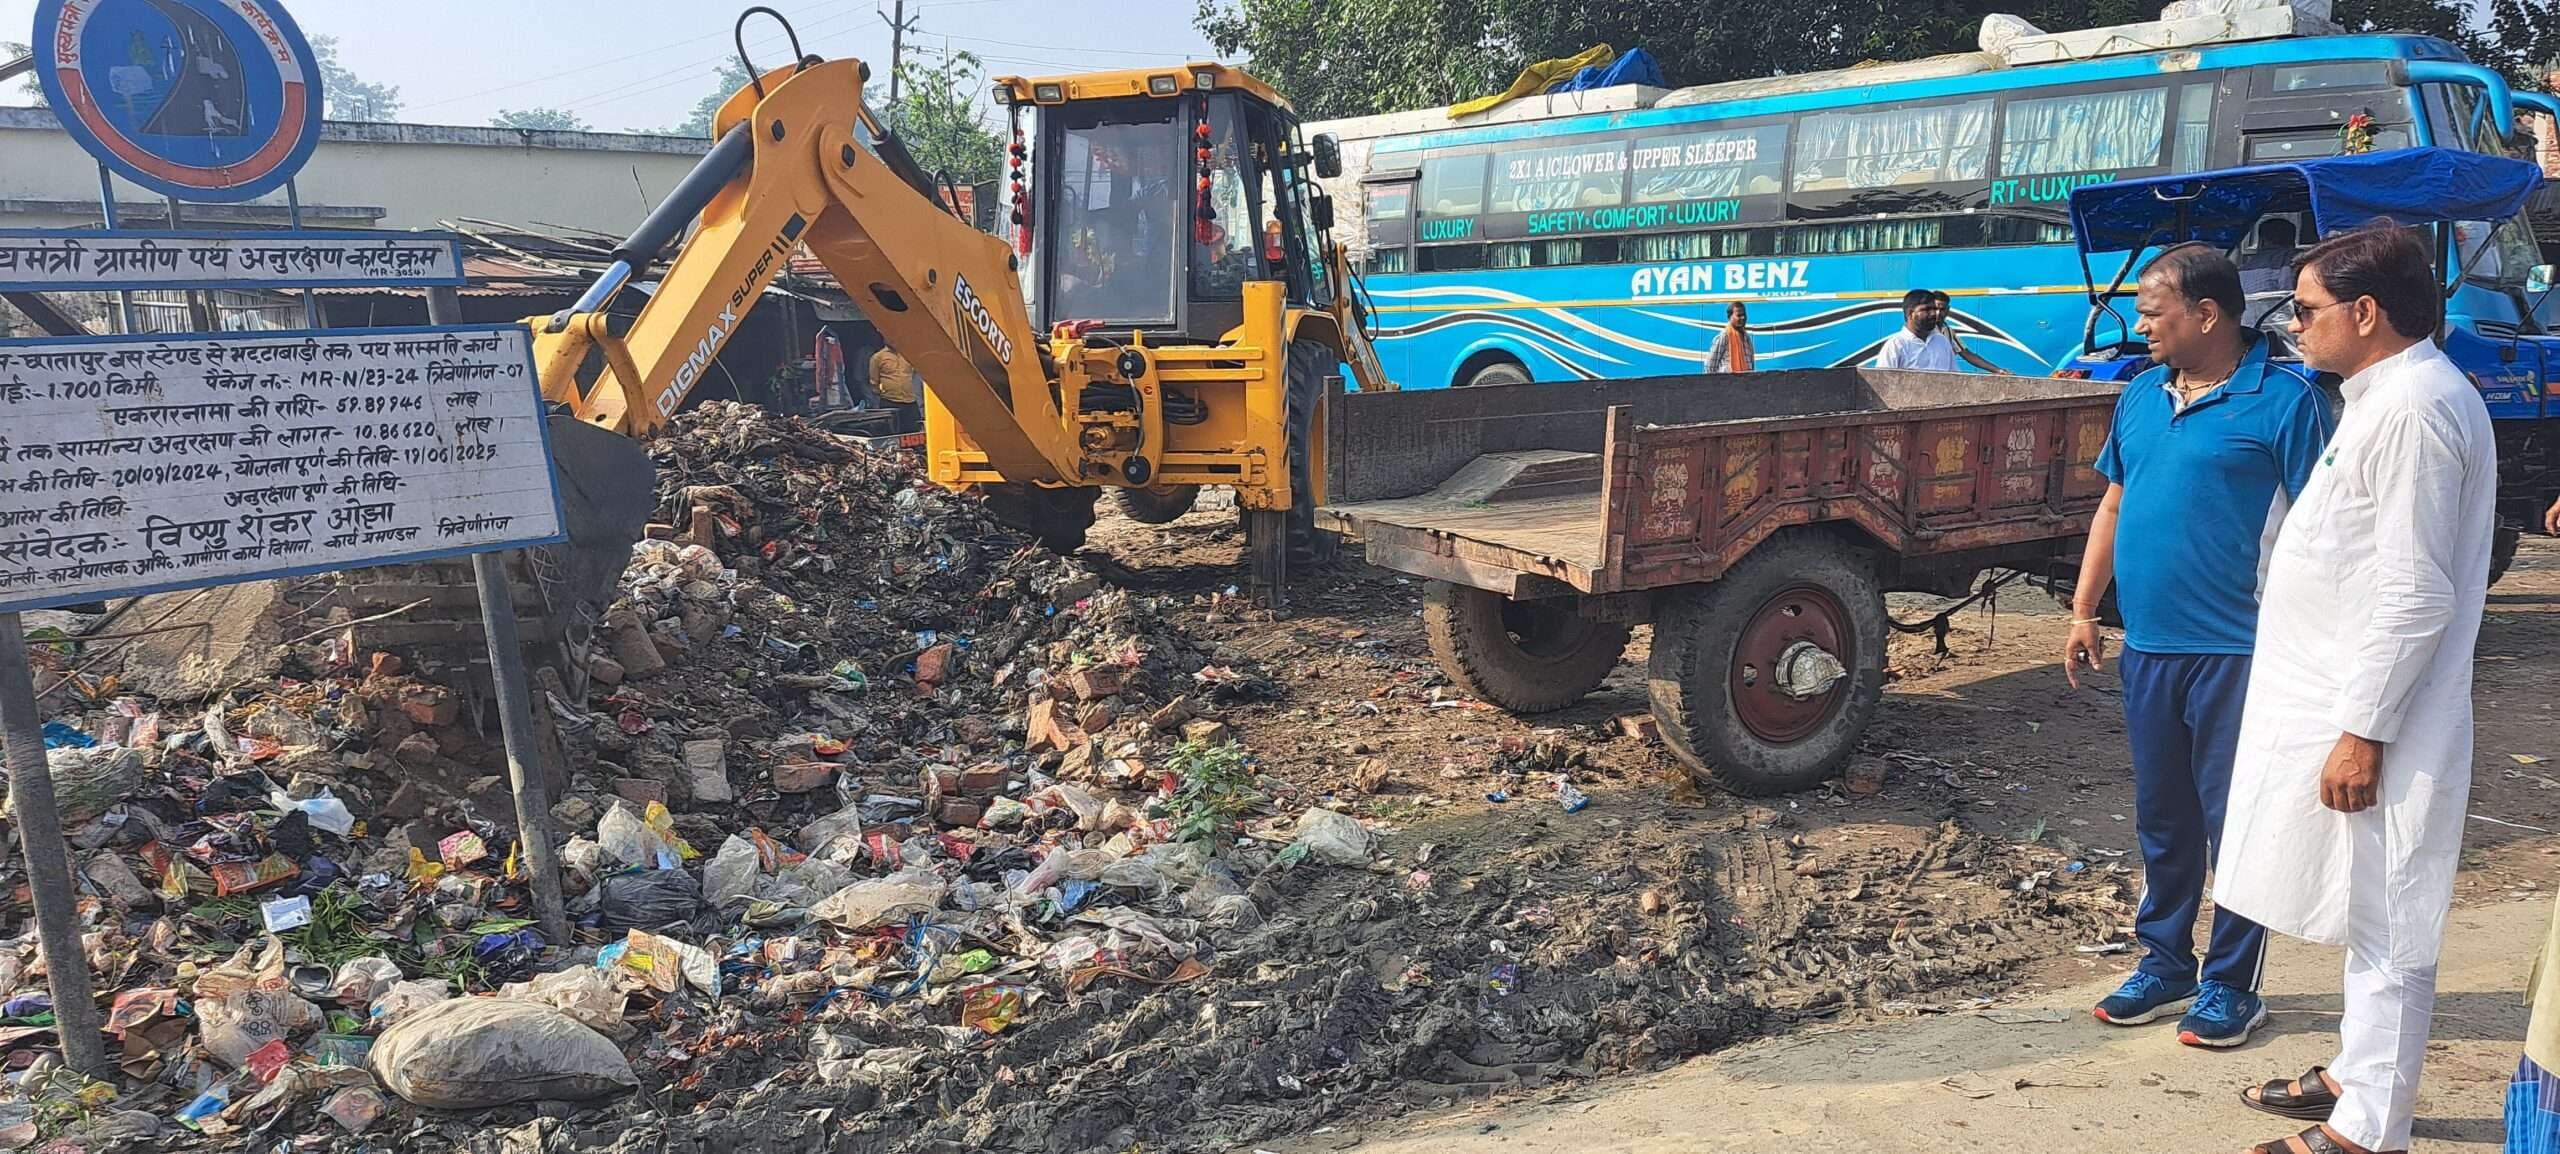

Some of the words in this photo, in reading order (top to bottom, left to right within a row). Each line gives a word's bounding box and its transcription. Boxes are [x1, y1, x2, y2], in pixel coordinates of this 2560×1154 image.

[1509, 160, 1532, 180] 2X1
[1562, 151, 1615, 176] LOWER
[1617, 151, 1628, 171] &
[1632, 147, 1681, 171] UPPER
[1685, 138, 1758, 166] SLEEPER
[1422, 217, 1475, 241] LUXURY
[1528, 210, 1585, 234] SAFETY
[1592, 204, 1668, 230] COMFORT
[1676, 200, 1742, 224] LUXURY
[94, 238, 183, 277] ग्रामीण
[239, 245, 346, 275] अनुरक्षण
[345, 239, 443, 269] कार्यक्रम
[732, 252, 776, 308] SUPER
[1632, 264, 1713, 296] AYAN
[1725, 261, 1809, 291] BENZ
[953, 272, 1014, 365] ESCORTS
[206, 342, 227, 367] से
[322, 343, 352, 361] तक
[358, 341, 391, 360] पथ
[463, 331, 502, 354] कार्य
[655, 305, 738, 418] DIGMAX
[238, 395, 269, 418] की
[17, 444, 52, 462] तक
[239, 424, 272, 447] की
[137, 514, 230, 549] विष्णु
[237, 508, 318, 541] शंकर
